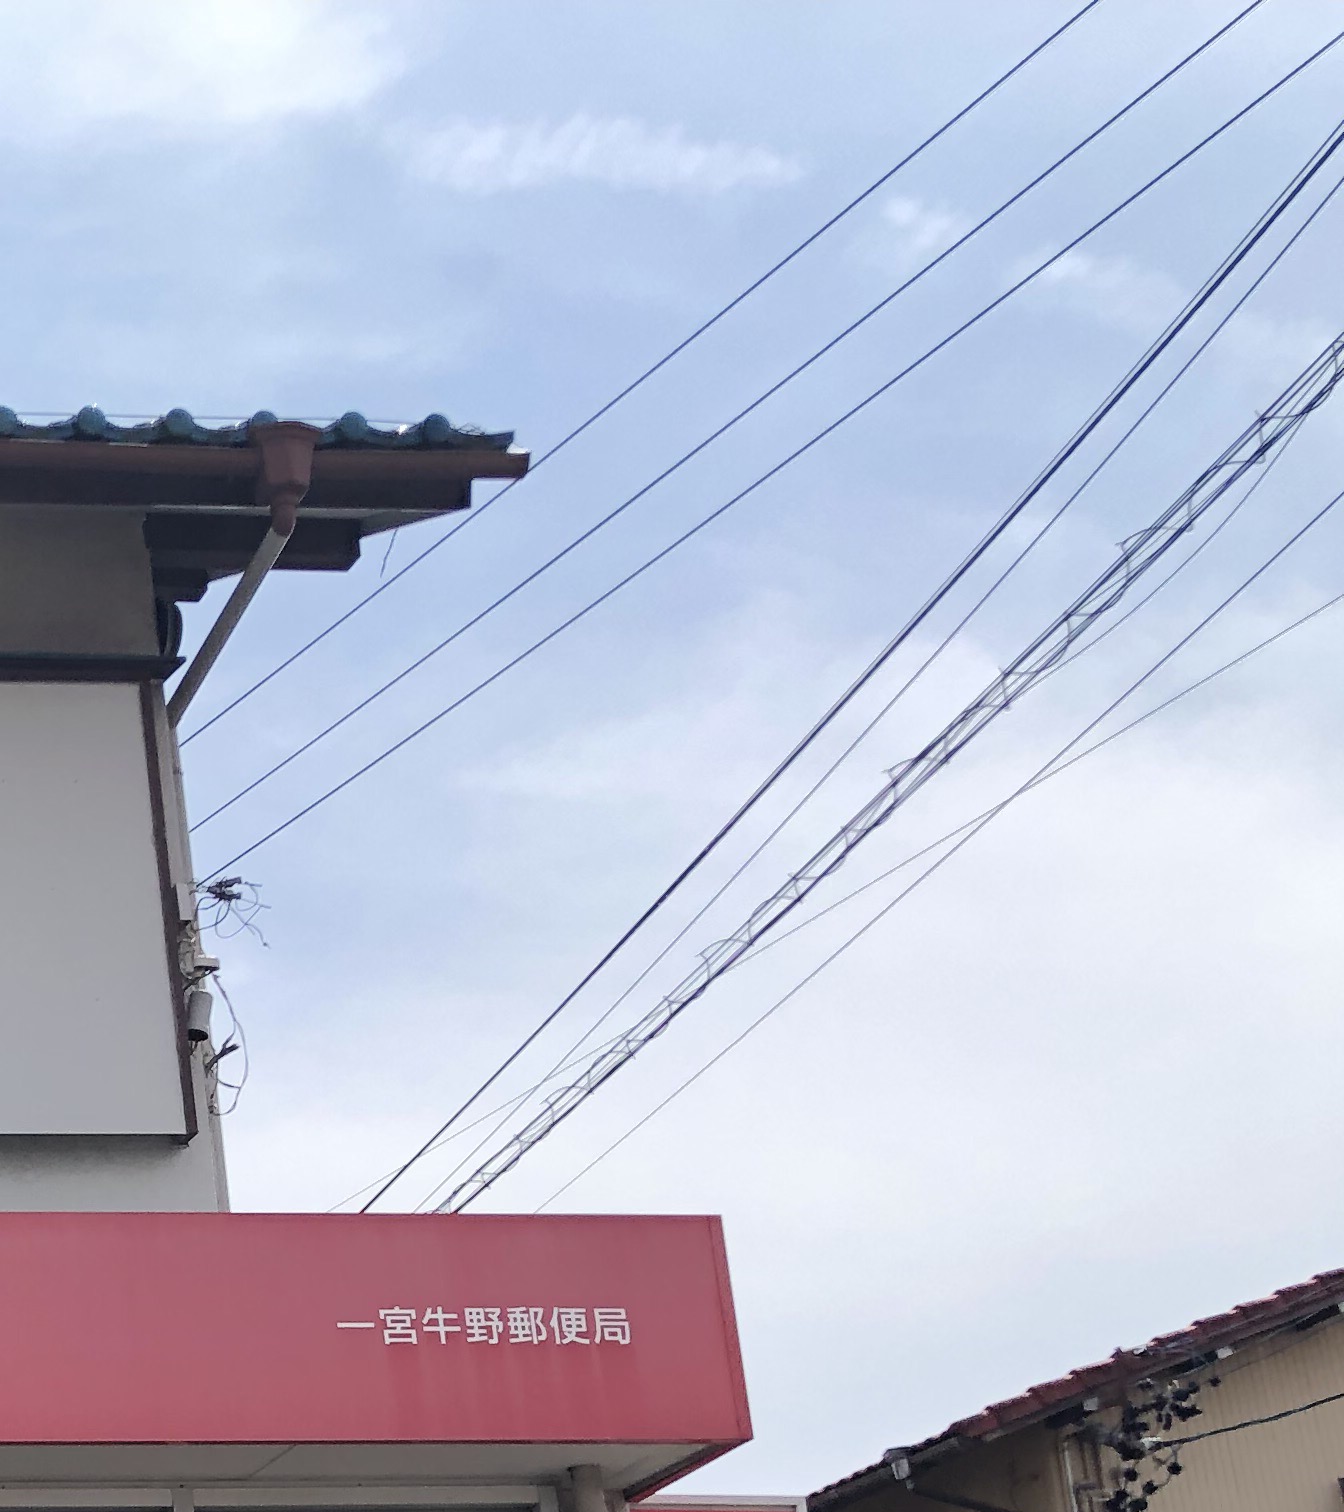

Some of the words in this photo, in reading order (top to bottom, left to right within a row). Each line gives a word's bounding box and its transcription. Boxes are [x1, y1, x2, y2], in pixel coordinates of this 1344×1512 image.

[336, 1306, 632, 1345] 一宮牛野郵便局
